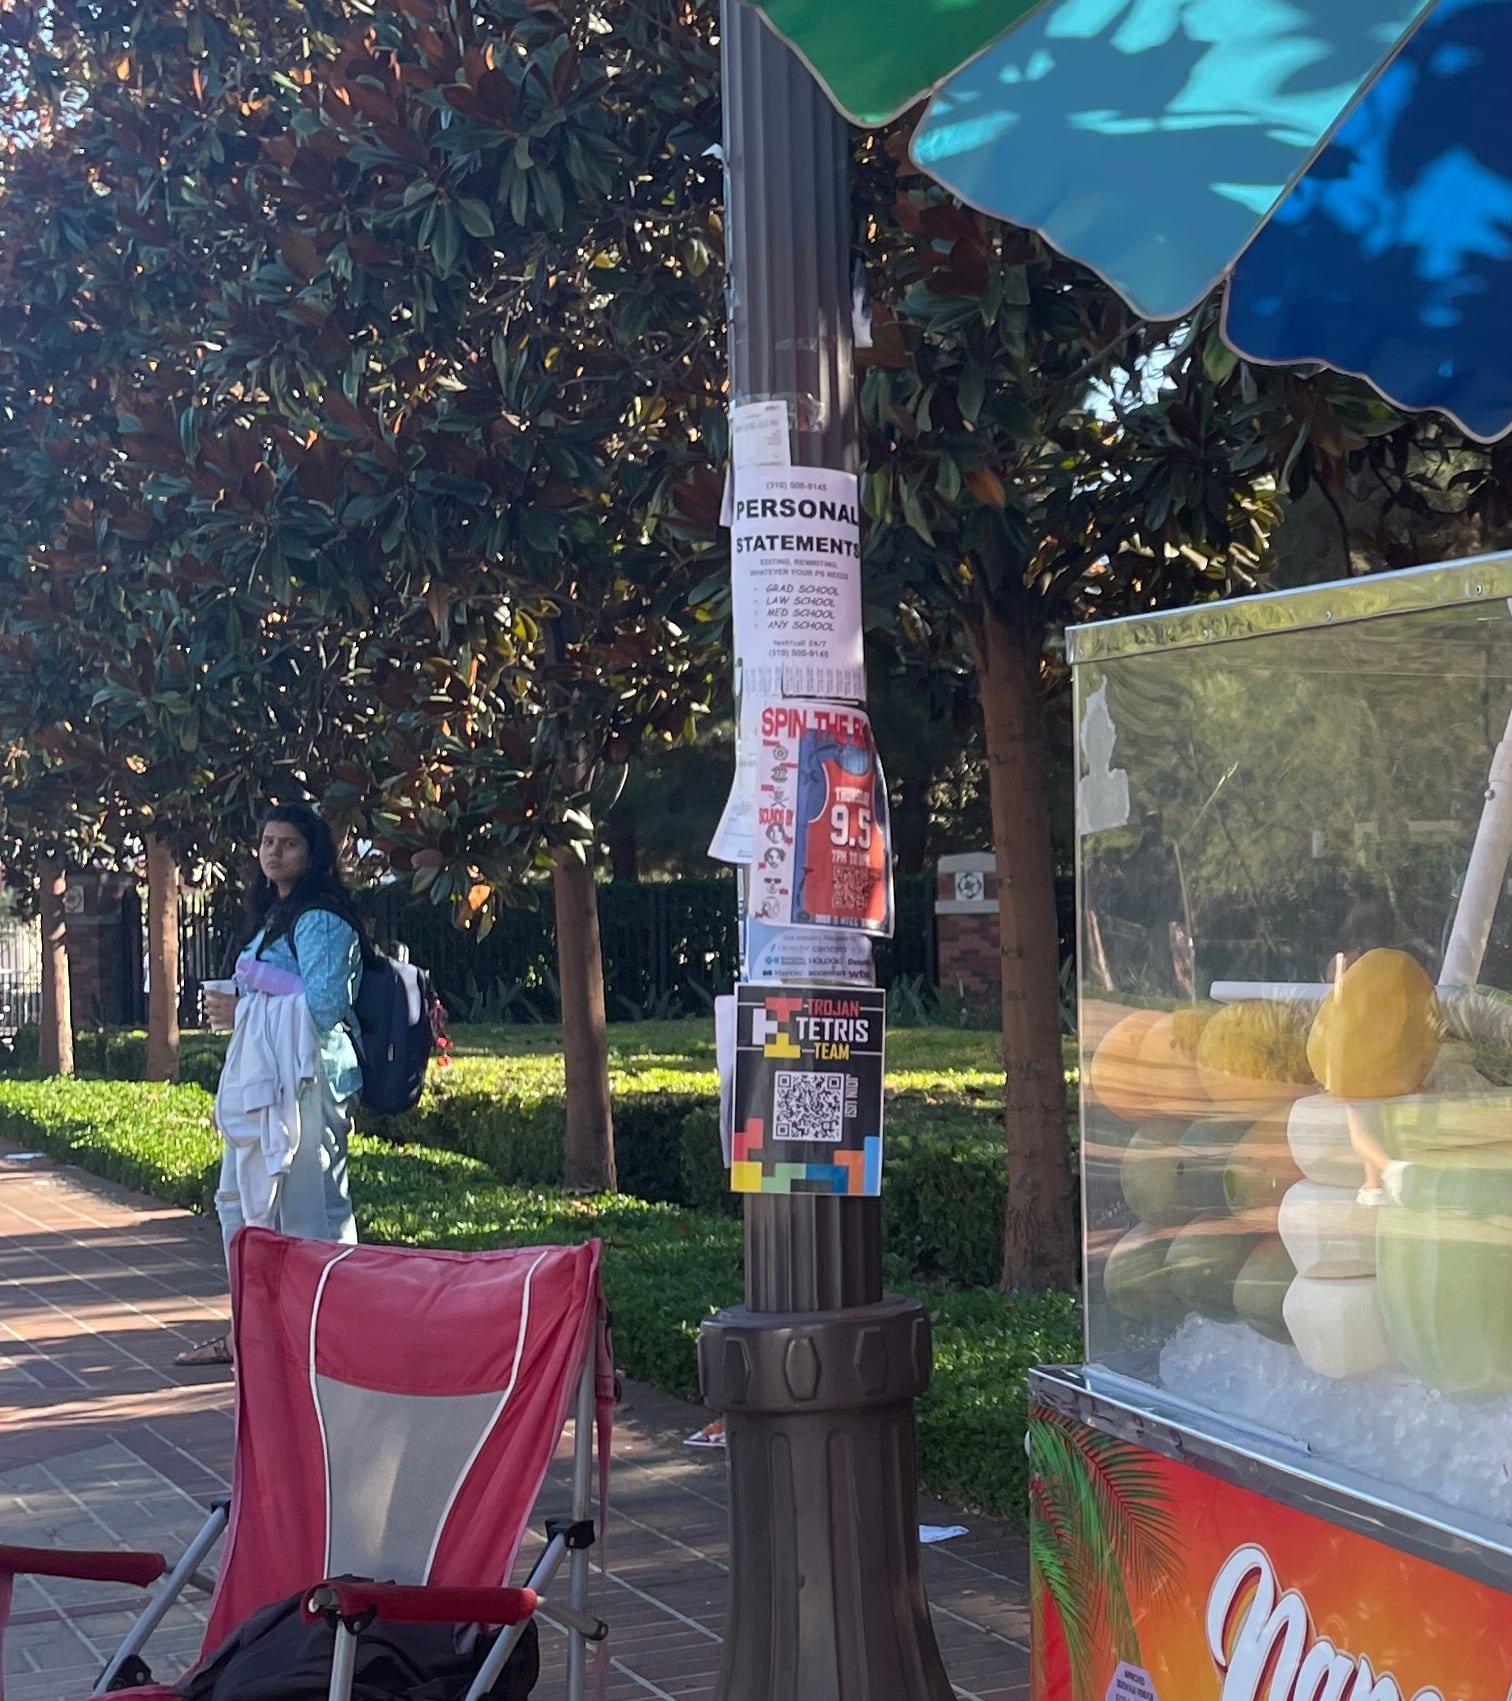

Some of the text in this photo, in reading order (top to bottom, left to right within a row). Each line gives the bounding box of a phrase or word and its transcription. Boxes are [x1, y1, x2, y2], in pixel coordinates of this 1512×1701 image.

[737, 498, 860, 527] PERSONAL
[736, 535, 860, 559] STATEMENTS
[766, 584, 839, 596] GRAD SCHOOL
[766, 596, 836, 607] LAW SCHOOL
[767, 607, 835, 619] MED SCHOOL
[768, 620, 834, 631] ANY SCHOOL
[761, 706, 807, 739] SPIN
[831, 804, 871, 850] 9.5
[807, 998, 859, 1017] TROJAN
[796, 1016, 869, 1042] TETRIS
[814, 1042, 850, 1060] TEAM
[845, 1073, 858, 1098] JOIN
